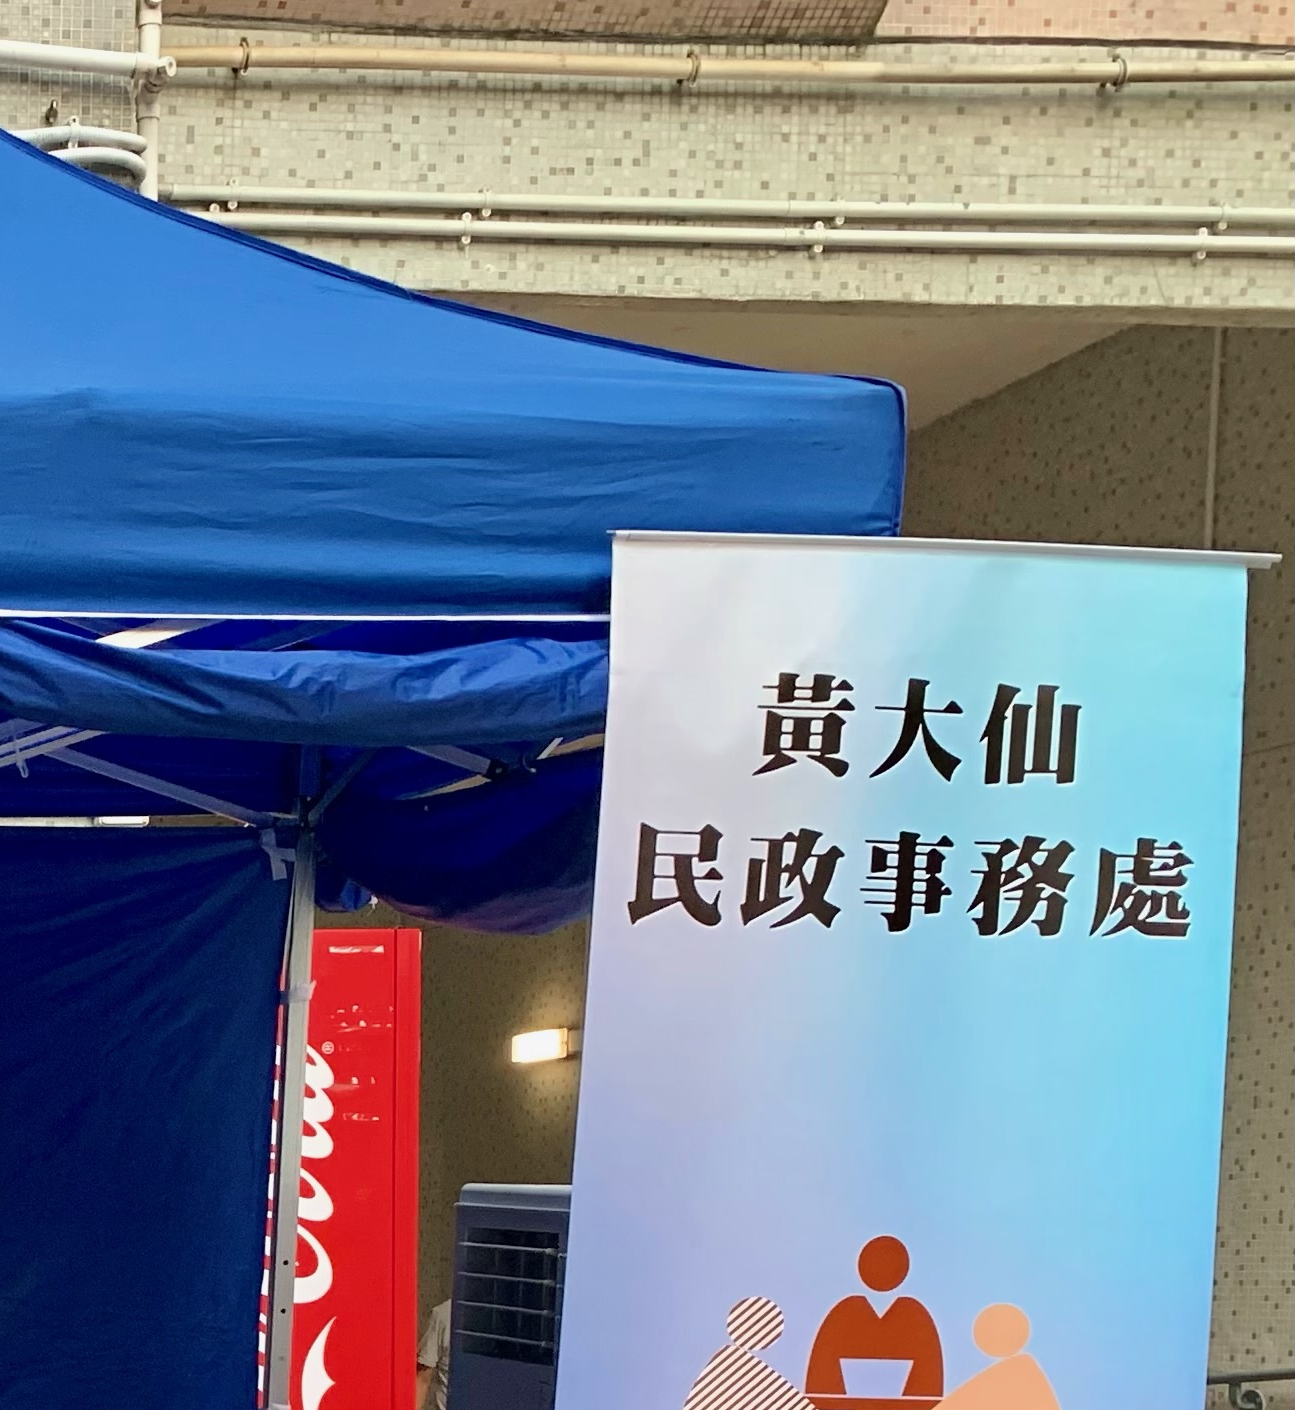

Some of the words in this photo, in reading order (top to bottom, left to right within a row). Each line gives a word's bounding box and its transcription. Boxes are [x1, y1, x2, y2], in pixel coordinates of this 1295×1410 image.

[752, 671, 1082, 785] 黃大仙
[626, 821, 1195, 938] 民政事務處
